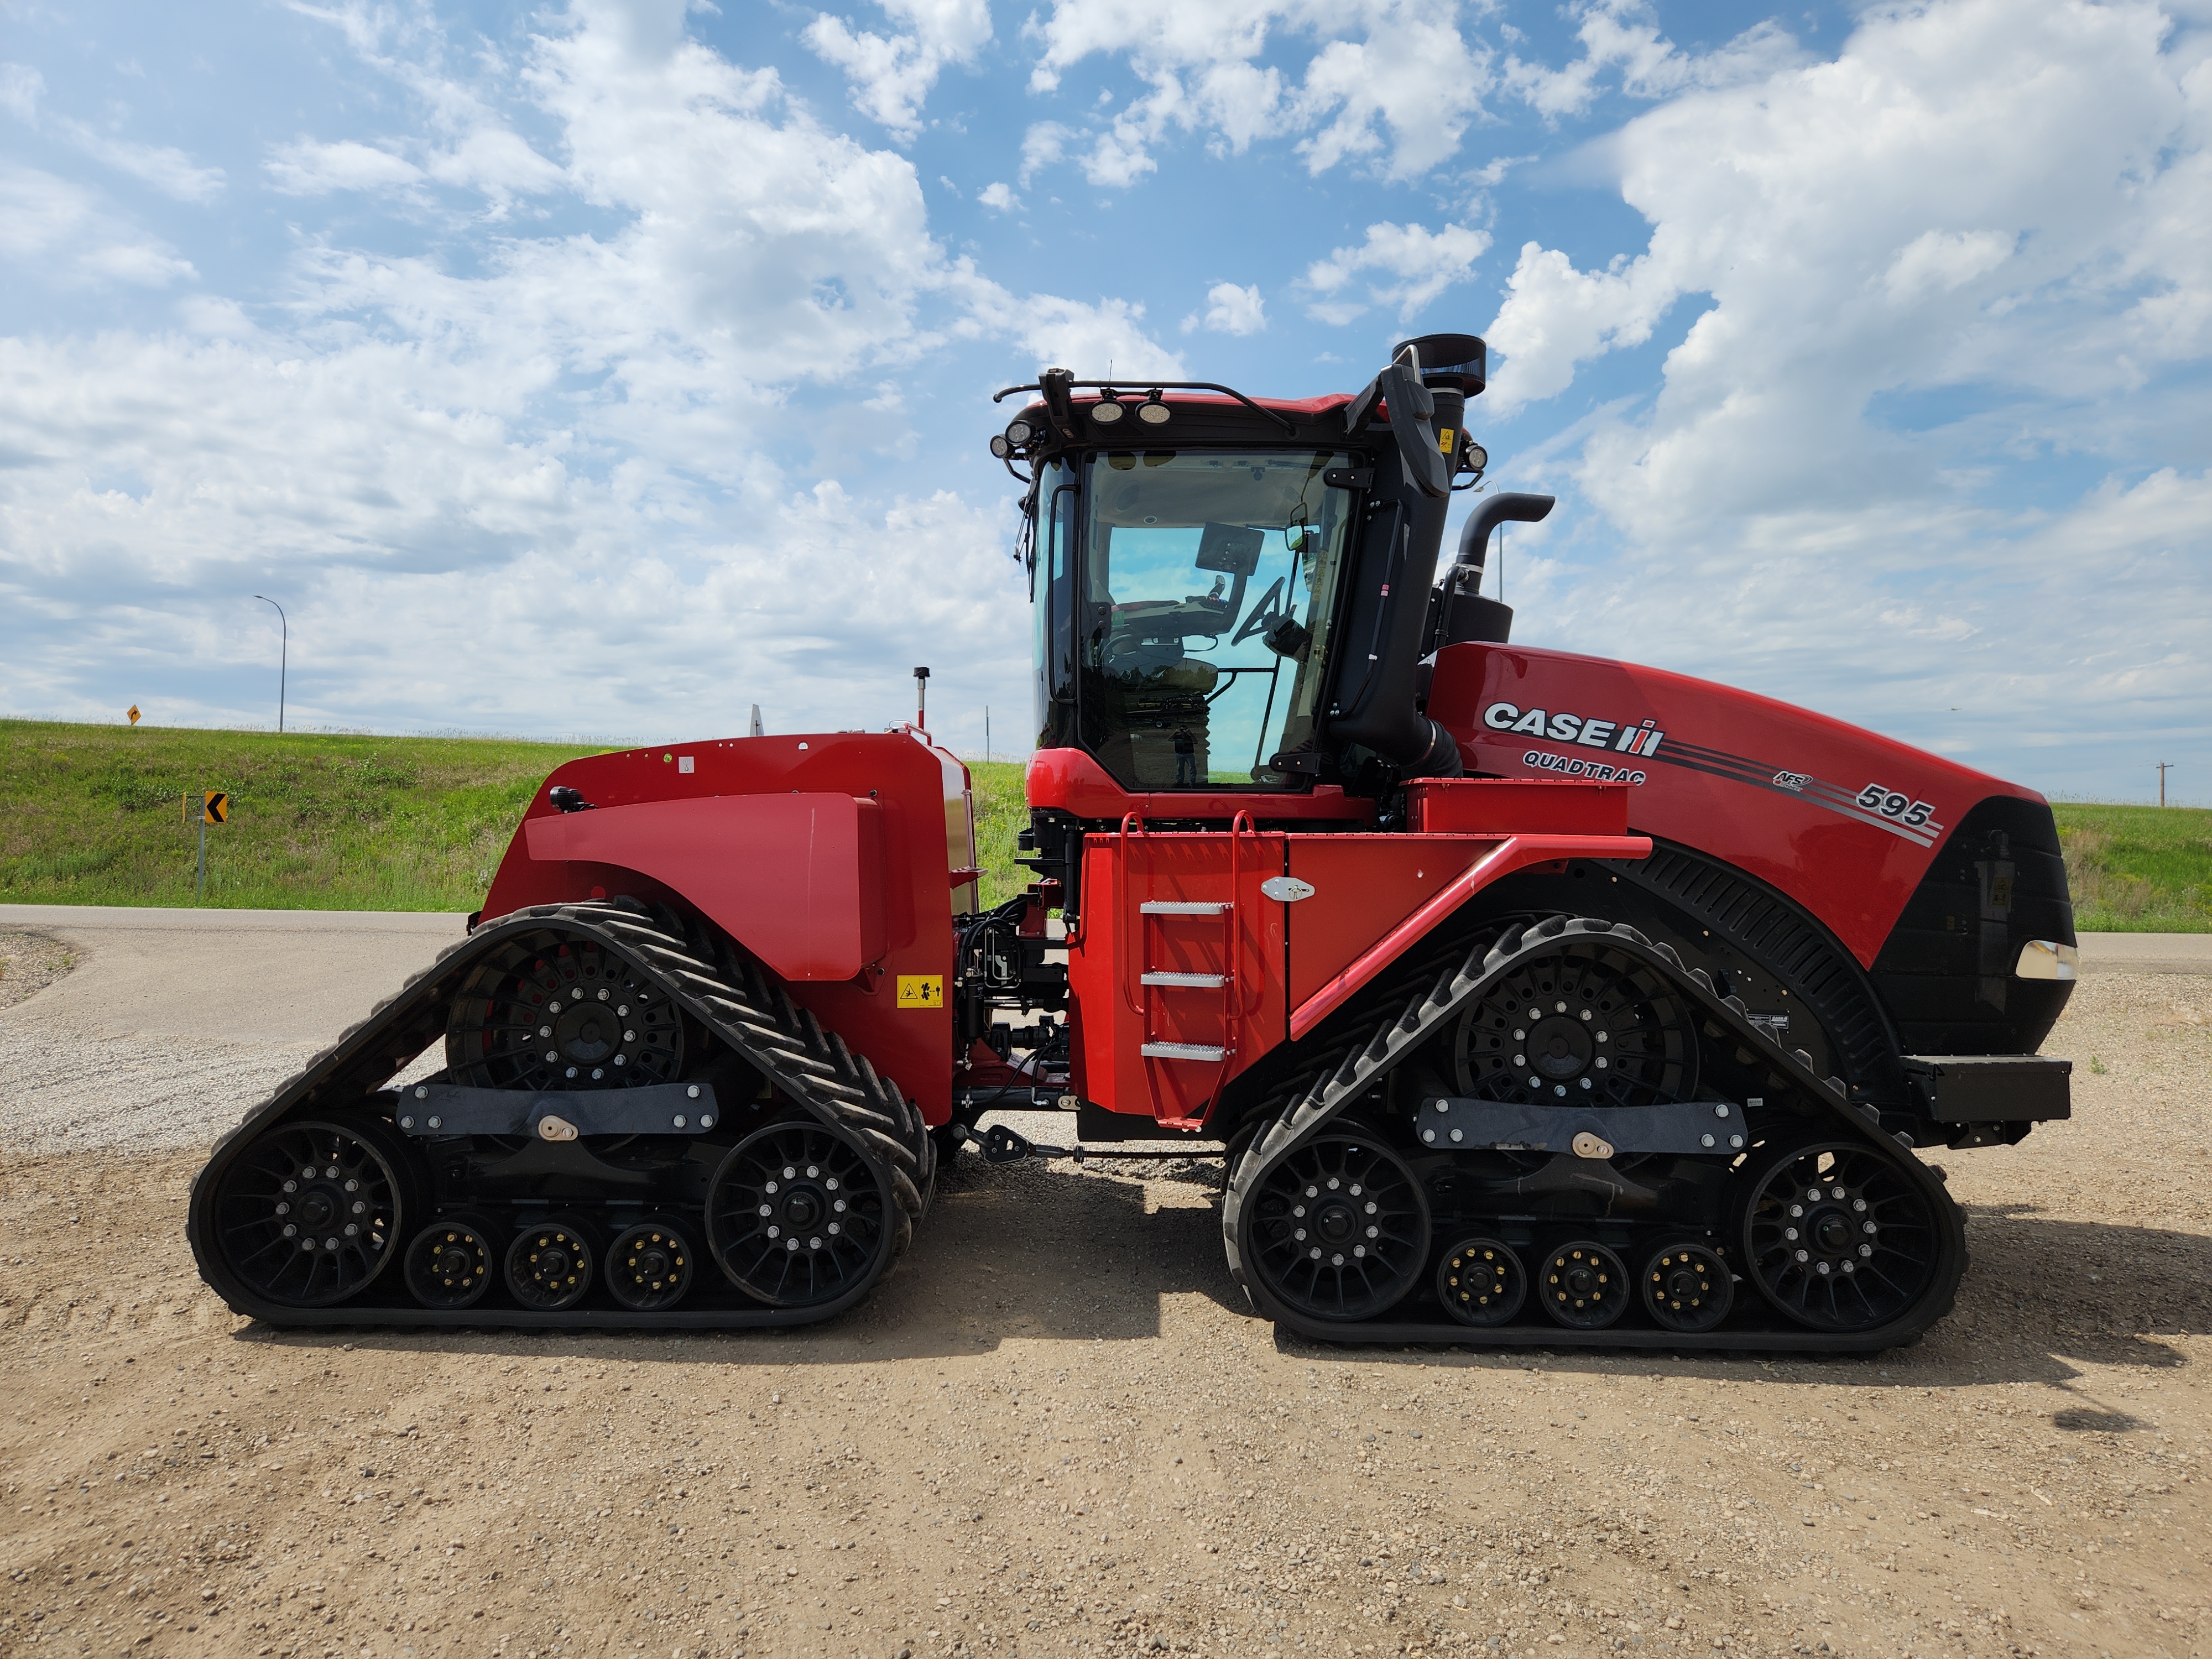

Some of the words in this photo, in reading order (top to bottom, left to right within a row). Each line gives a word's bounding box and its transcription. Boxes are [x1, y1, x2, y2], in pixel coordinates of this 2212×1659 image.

[1484, 702, 1616, 747] CASE
[1523, 750, 1646, 786] QUADTRAC
[1773, 770, 1806, 785] AFS
[1856, 783, 1935, 826] 595
